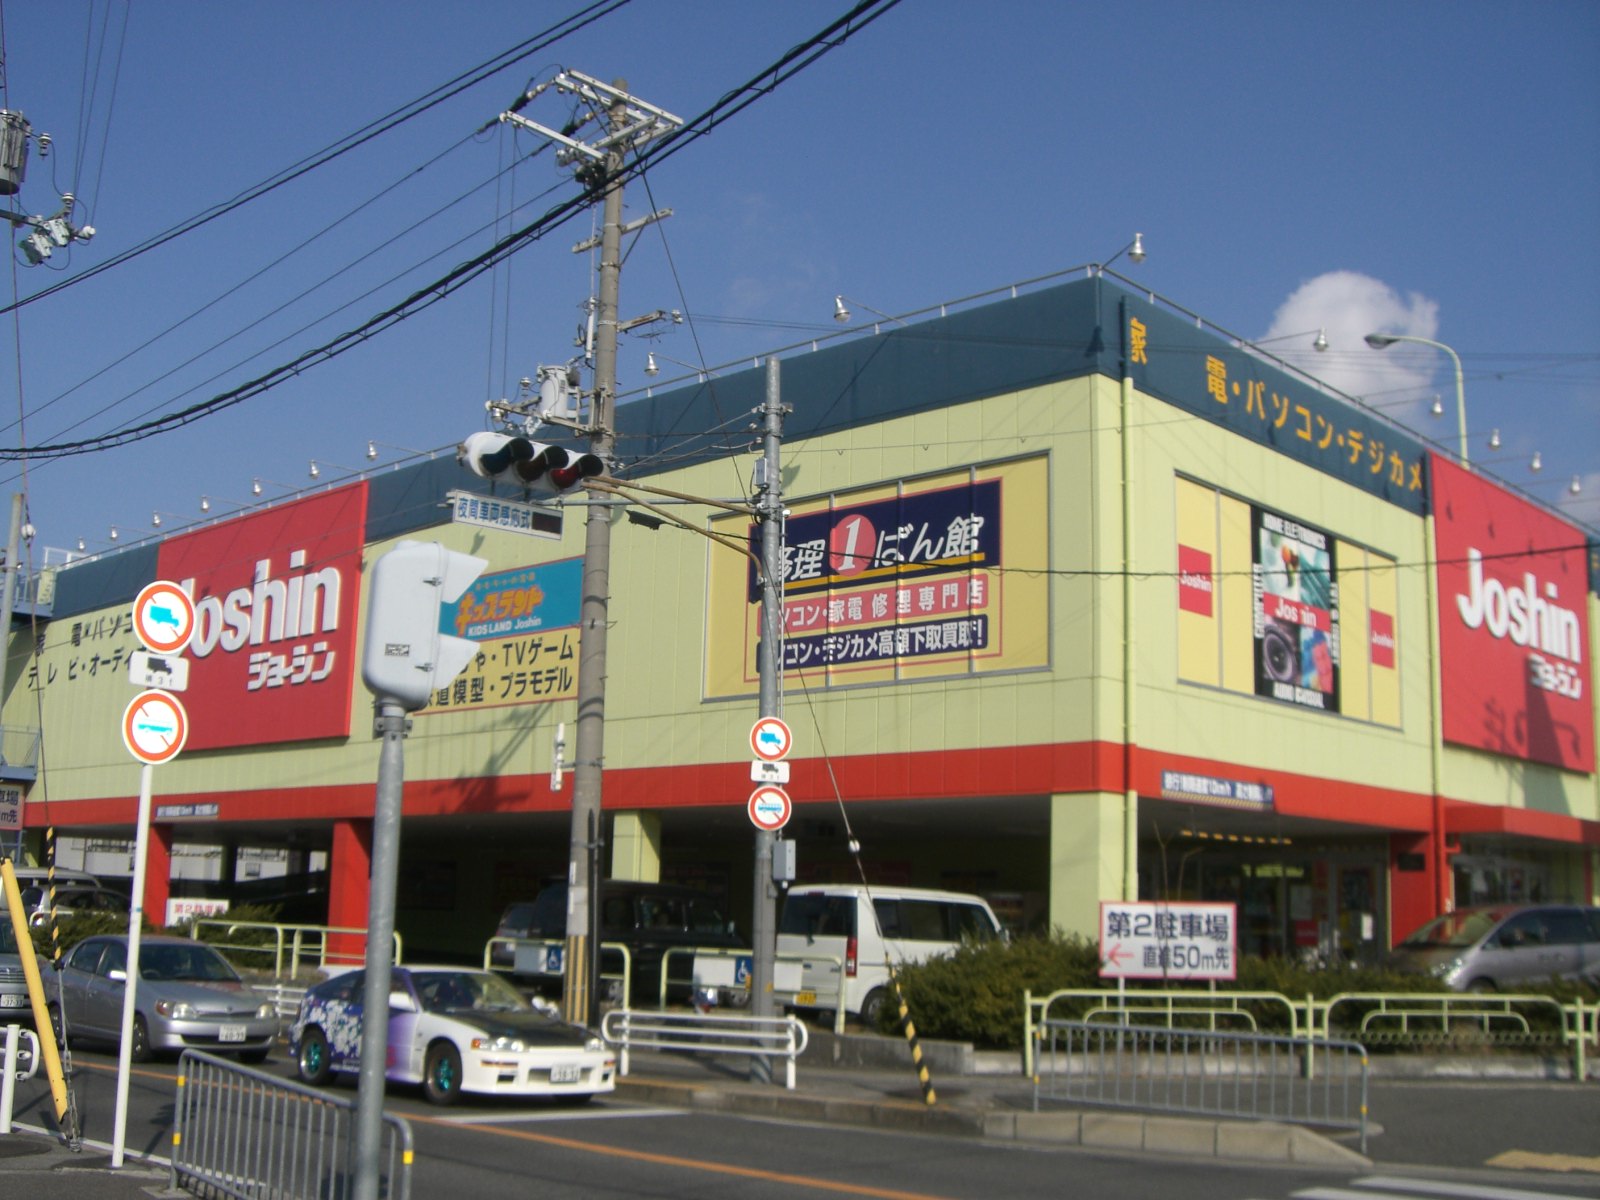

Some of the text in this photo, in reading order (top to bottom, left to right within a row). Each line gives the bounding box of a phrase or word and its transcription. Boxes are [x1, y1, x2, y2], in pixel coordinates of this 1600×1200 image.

[1181, 570, 1212, 592] Joshin
[181, 549, 341, 658] oshin
[1456, 547, 1581, 664] Joshin
[467, 616, 542, 637] KIDS LAND Joshin
[429, 666, 573, 707] 道模型・プラモデル
[1107, 911, 1229, 941] 第2駐車場
